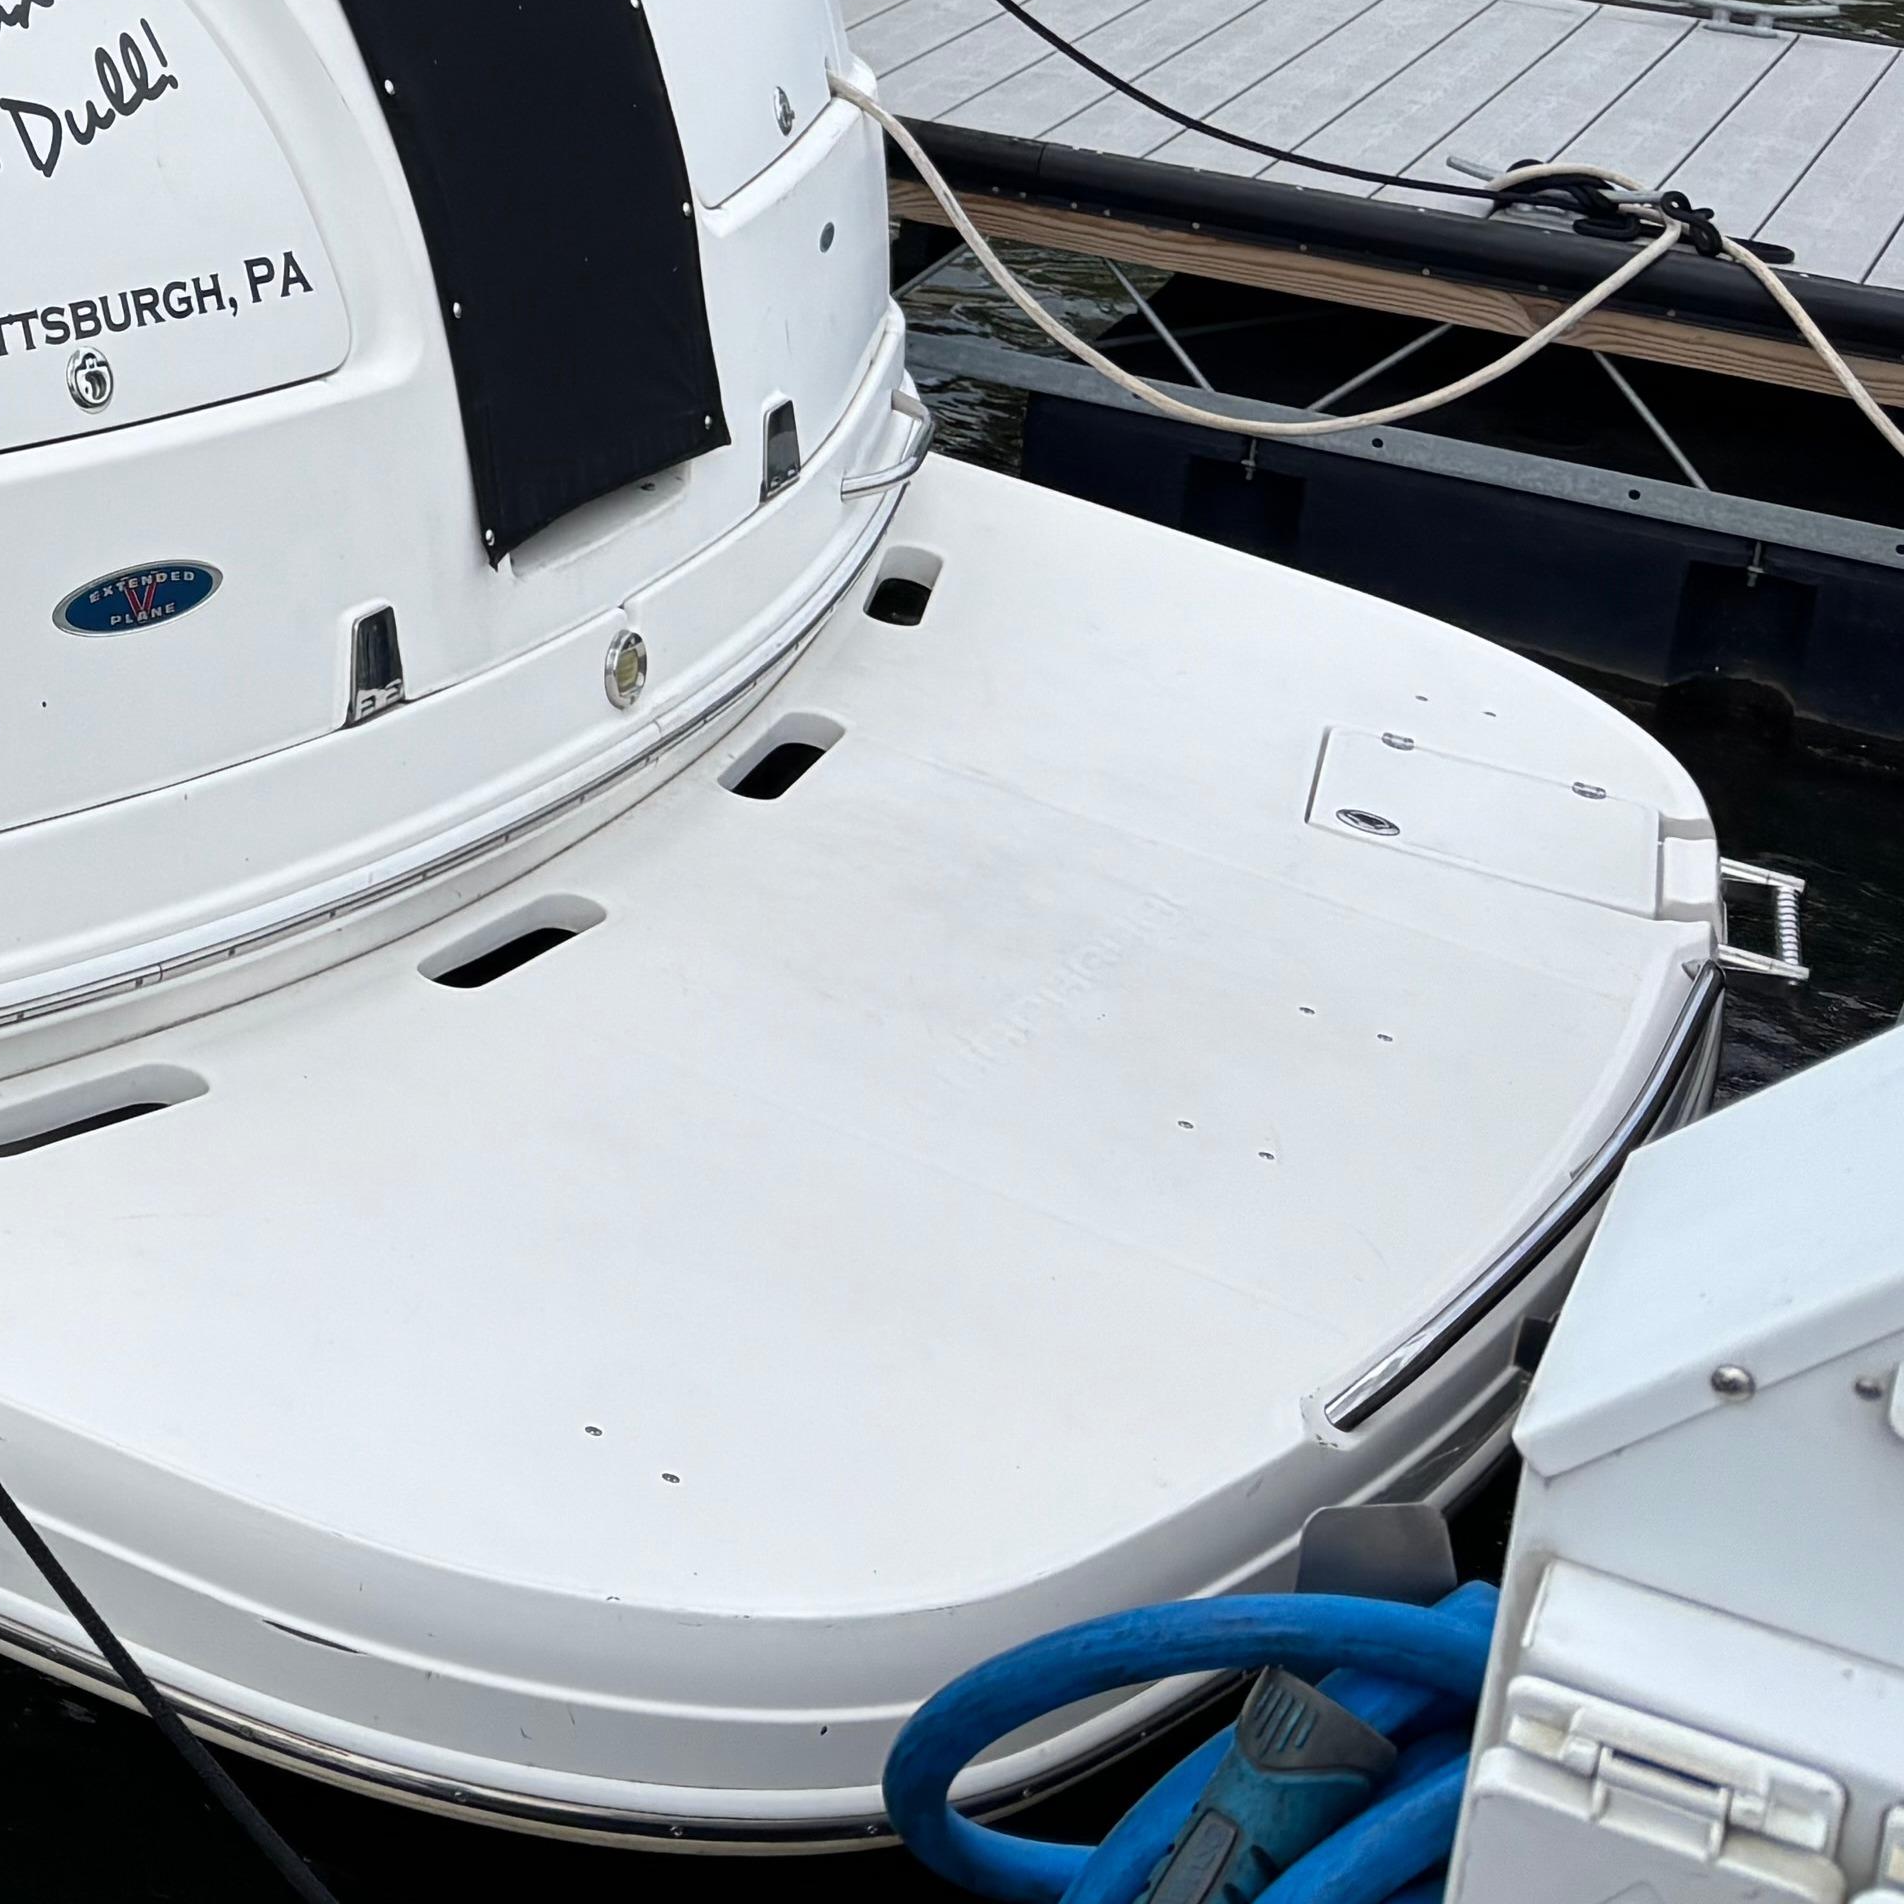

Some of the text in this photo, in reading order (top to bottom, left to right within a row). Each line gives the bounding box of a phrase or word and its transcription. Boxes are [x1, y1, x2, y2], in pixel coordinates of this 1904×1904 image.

[243, 250, 315, 305] PA
[88, 570, 196, 604] EXTENDED
[110, 602, 176, 626] PLANE
